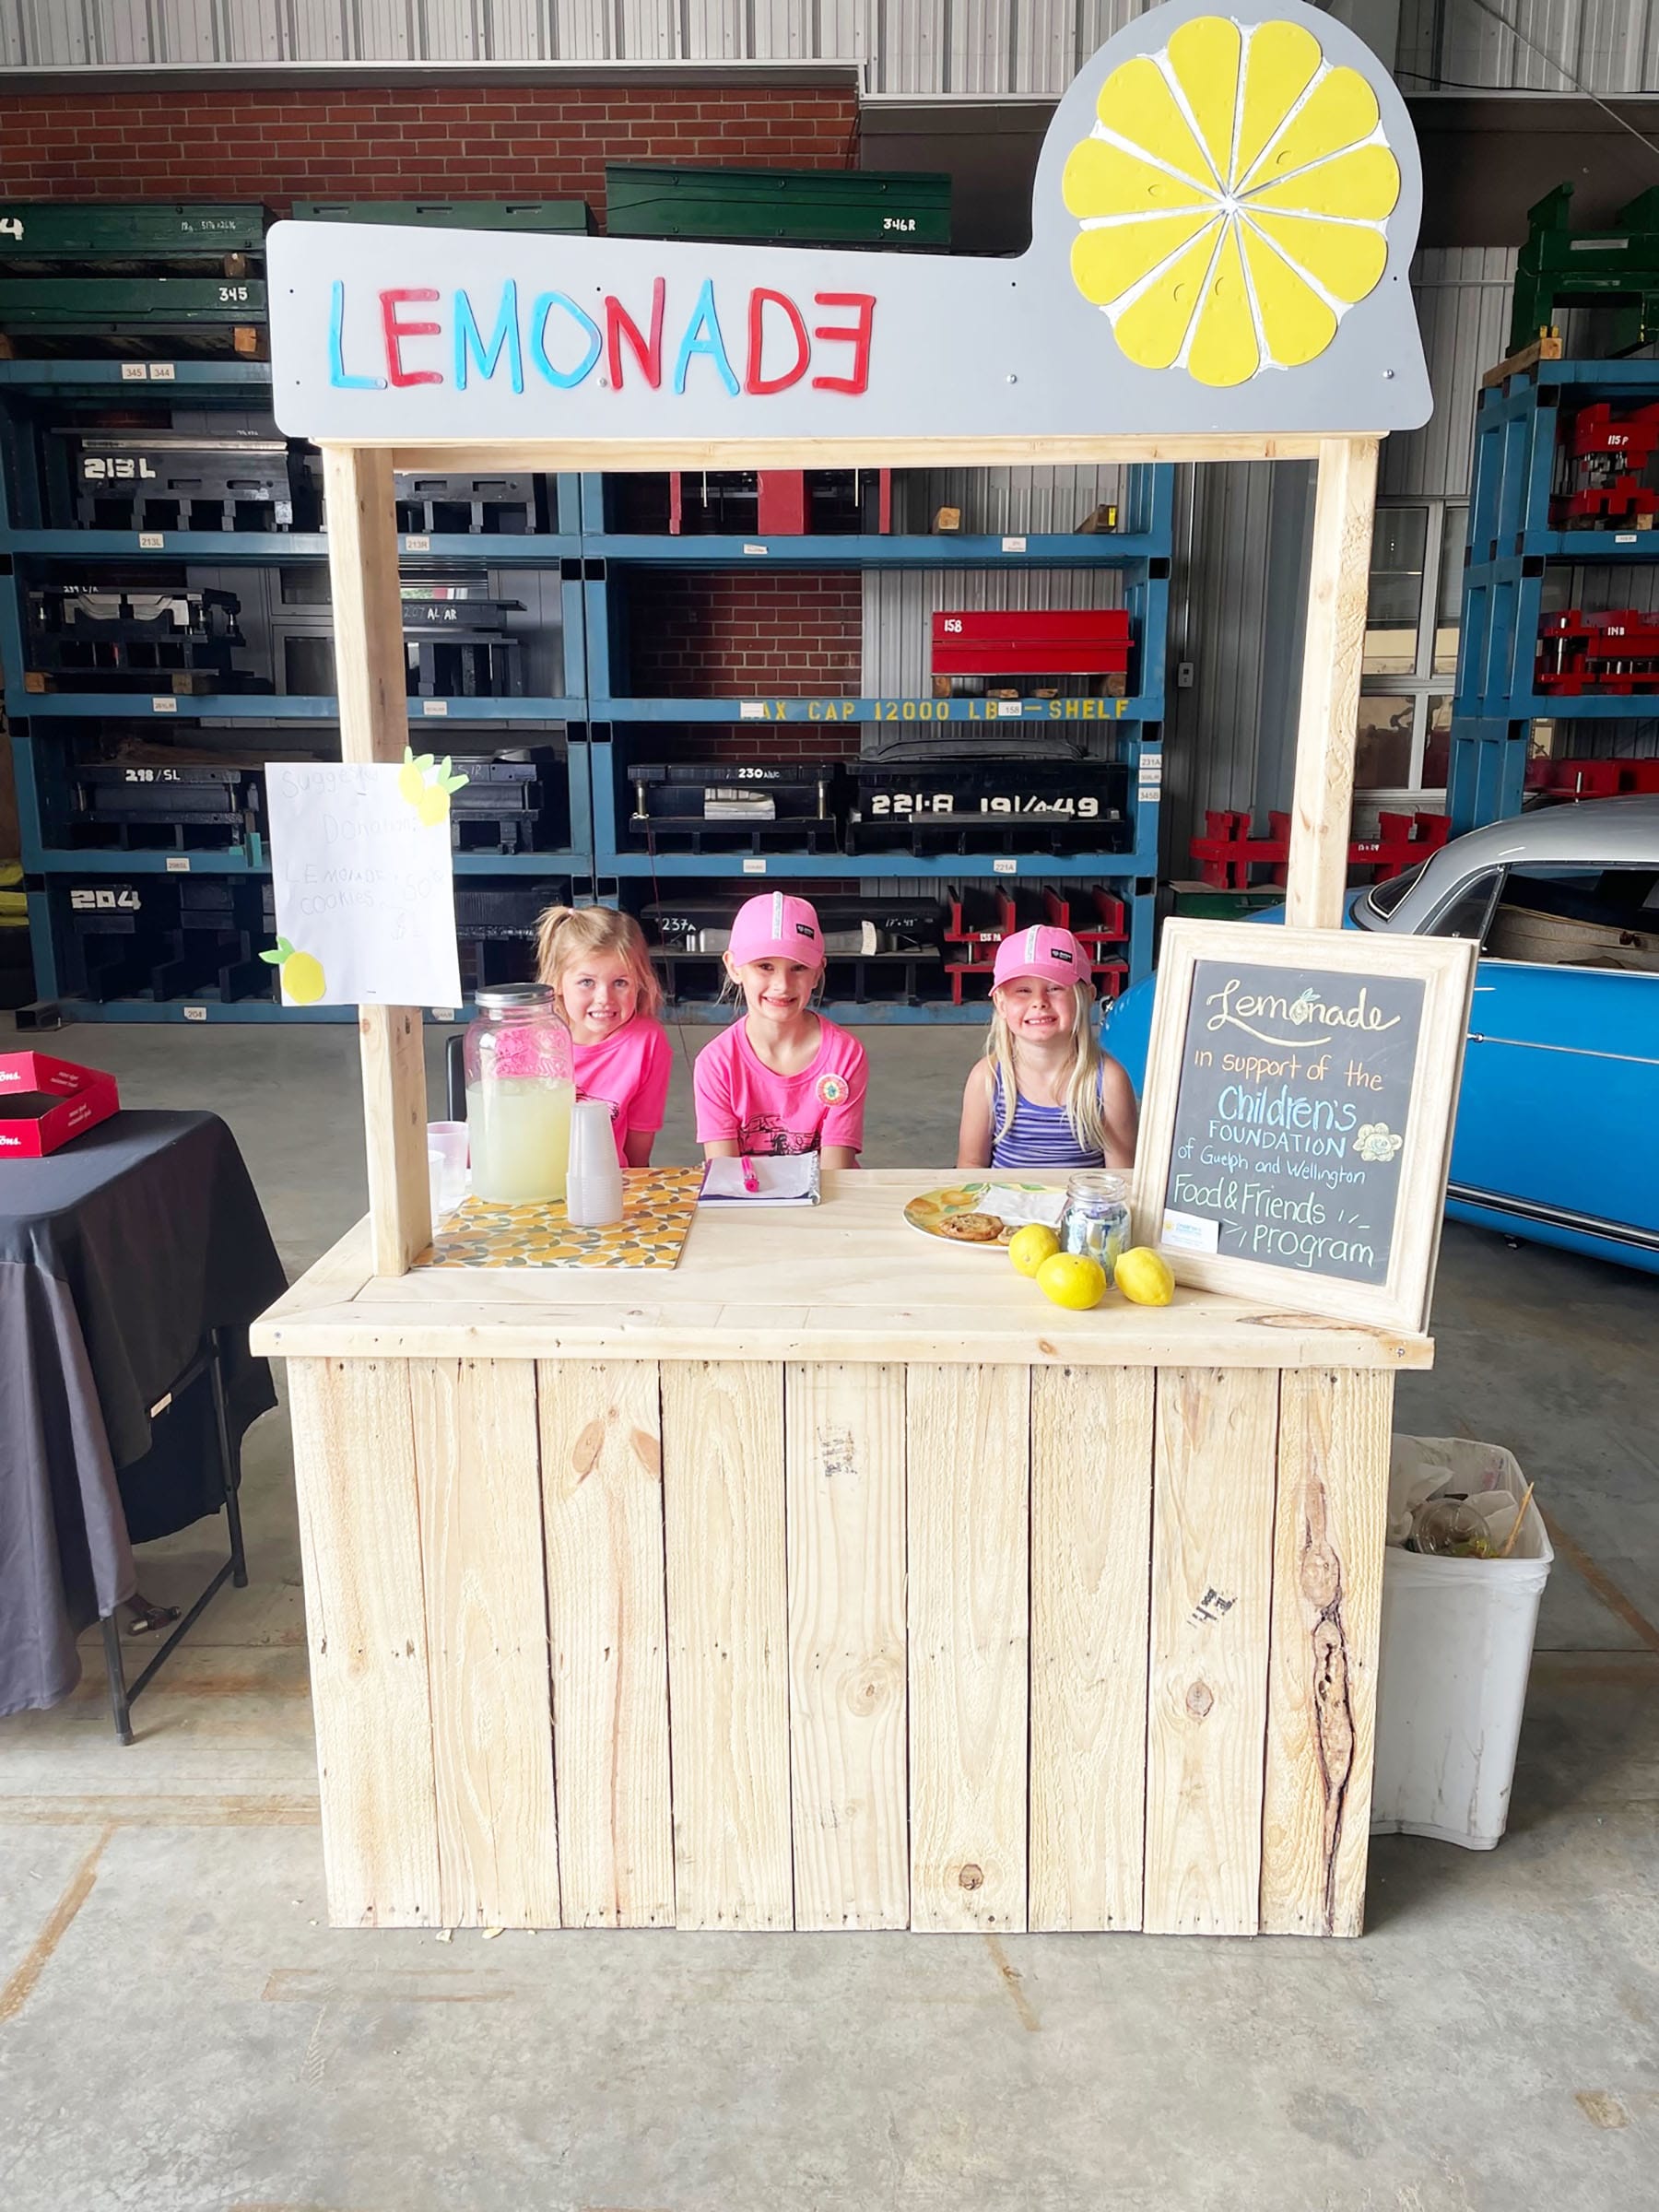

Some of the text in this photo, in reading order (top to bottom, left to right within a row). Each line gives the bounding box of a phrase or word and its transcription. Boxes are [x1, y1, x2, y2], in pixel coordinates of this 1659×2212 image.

[883, 218, 916, 232] 346R
[218, 287, 248, 301] 345
[125, 369, 143, 378] 345
[154, 369, 171, 378] 344
[141, 537, 161, 547] 213L
[944, 618, 962, 633] 158
[807, 700, 855, 721] CAP
[874, 700, 950, 721] 12000
[1049, 700, 1130, 720] SHELF
[1005, 706, 1020, 715] 158
[738, 768, 763, 779] 230
[995, 864, 1015, 872] 221A
[70, 890, 142, 911] 204
[1206, 979, 1401, 1031] Lemonade
[1194, 1050, 1383, 1090] in support of the
[1218, 1084, 1357, 1133] Children's
[1209, 1120, 1346, 1159] FOUNDATION
[1178, 1138, 1365, 1189] of Guelph and Wellington
